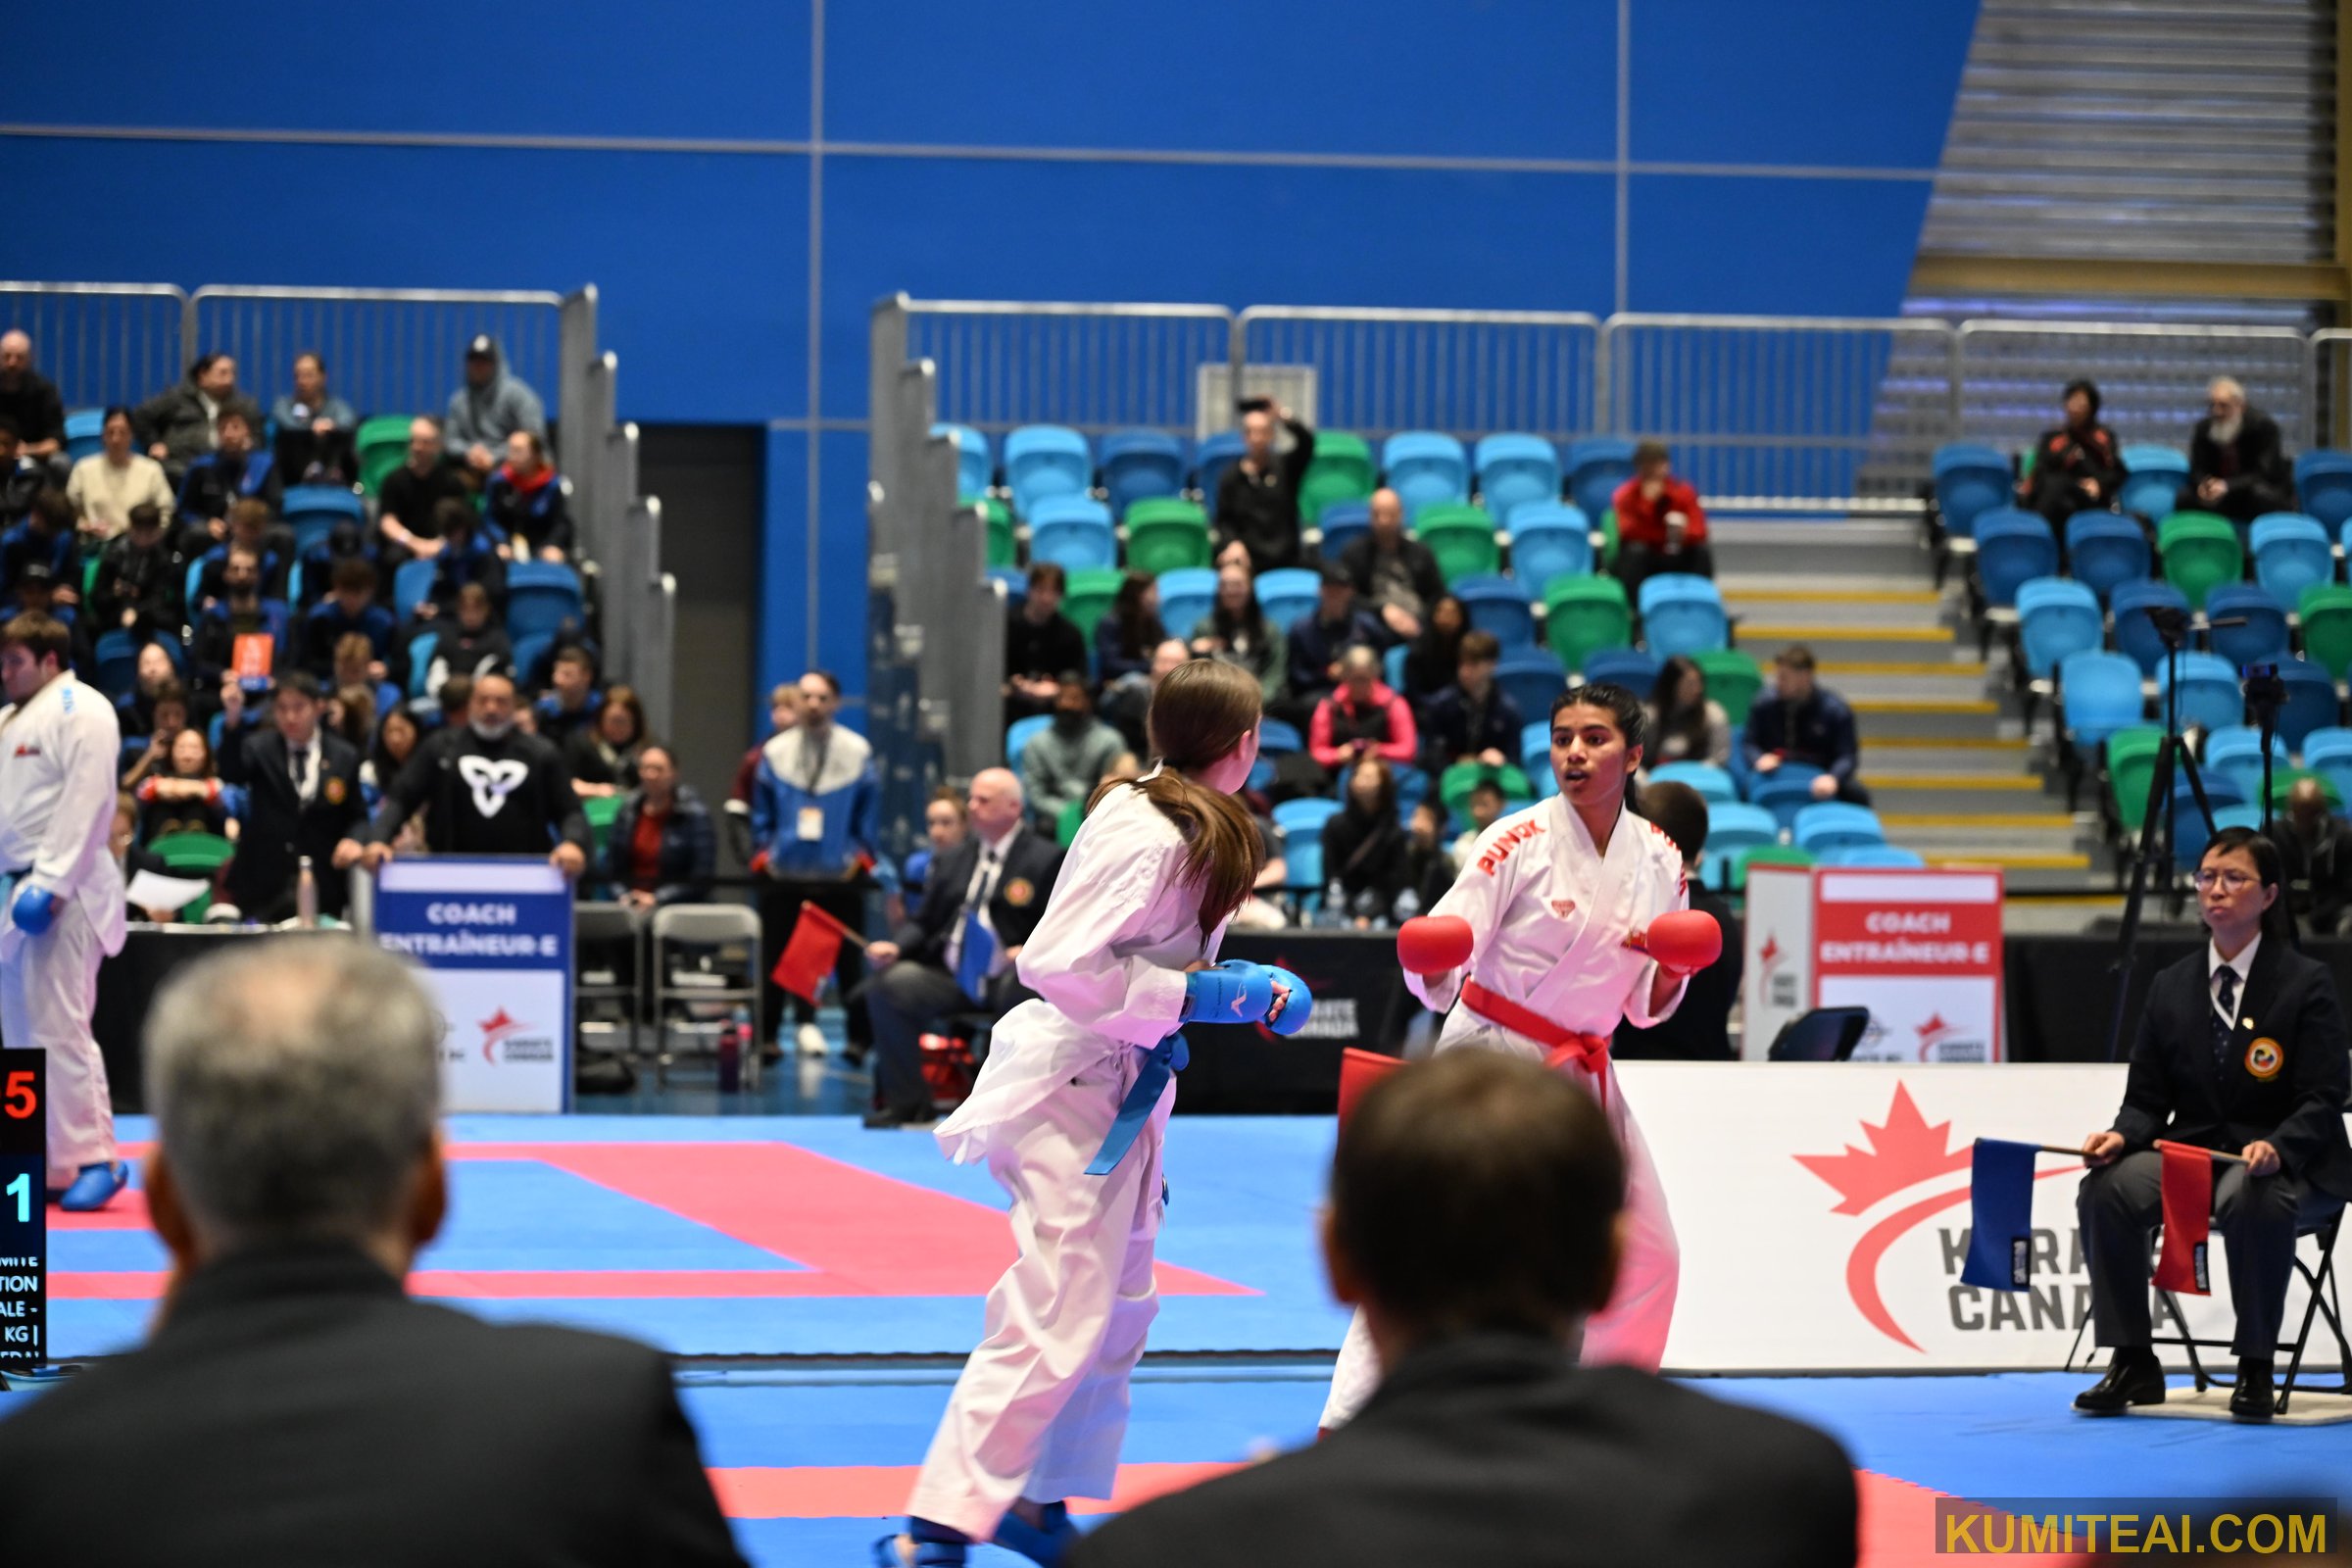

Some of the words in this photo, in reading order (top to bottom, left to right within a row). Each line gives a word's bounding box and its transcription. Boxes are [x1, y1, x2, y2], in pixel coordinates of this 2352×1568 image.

[426, 904, 516, 924] COACH
[1866, 911, 1952, 933] COACH
[5, 1070, 36, 1118] 5
[6, 1173, 30, 1222] 1
[5, 1325, 28, 1343] KG
